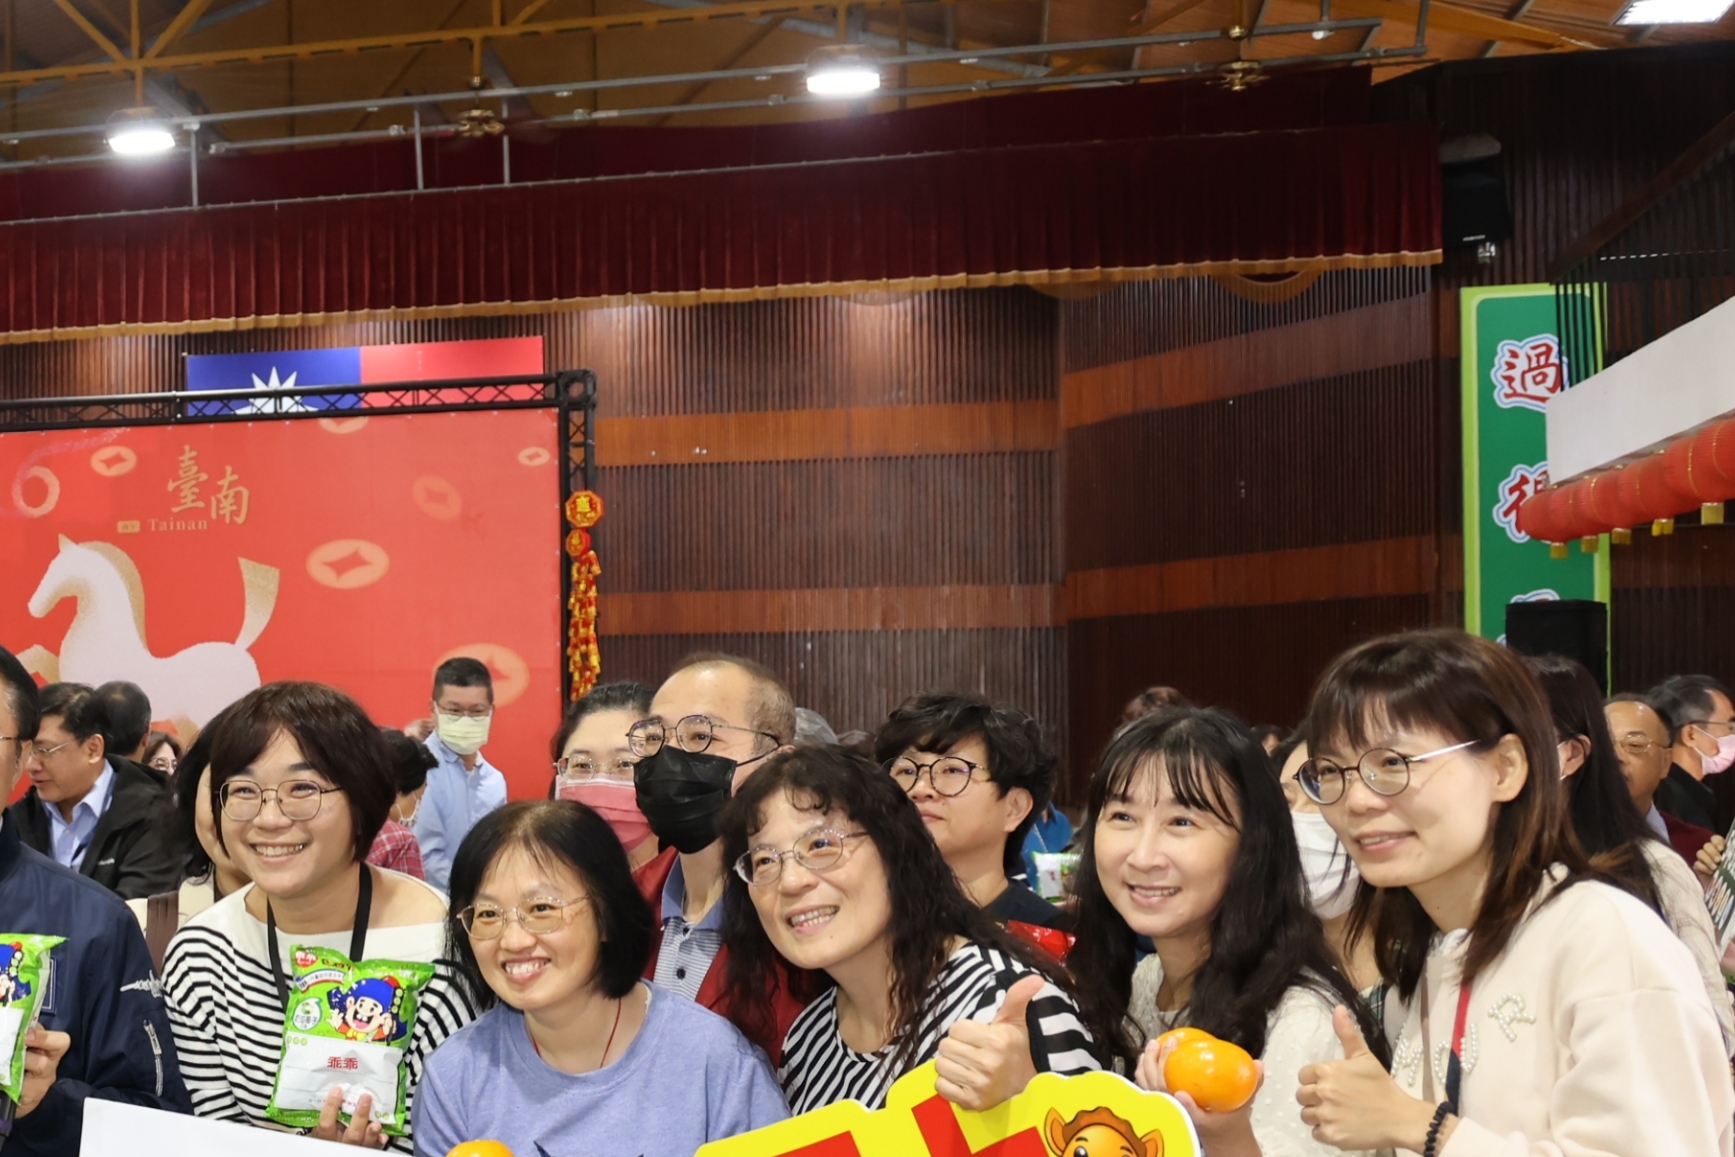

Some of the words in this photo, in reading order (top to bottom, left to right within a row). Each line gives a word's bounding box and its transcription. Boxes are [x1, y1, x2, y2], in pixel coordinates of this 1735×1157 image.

[167, 444, 251, 525] 臺南
[147, 516, 208, 532] Tainan
[327, 1056, 359, 1071] 乖乖
